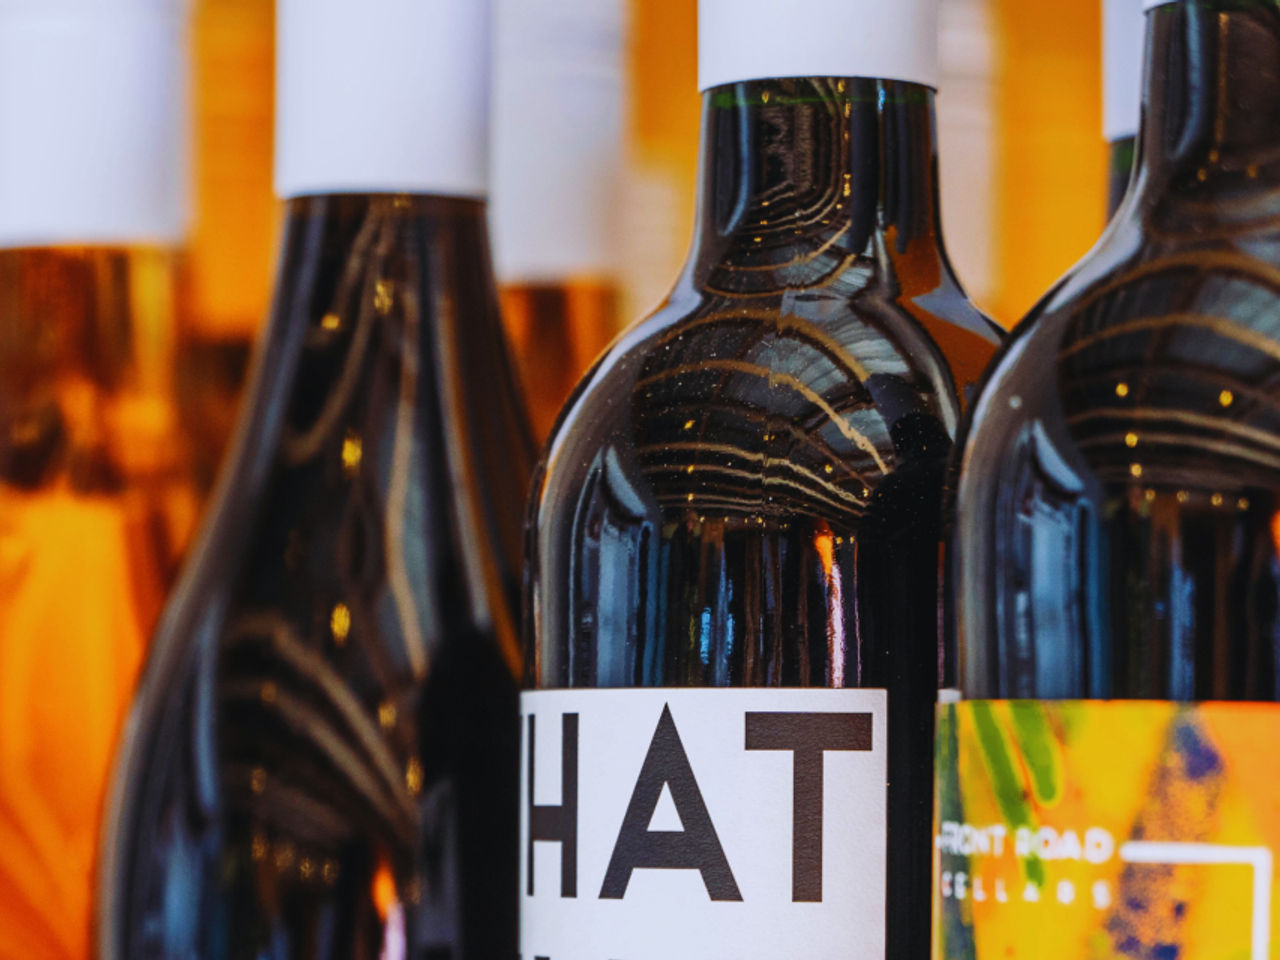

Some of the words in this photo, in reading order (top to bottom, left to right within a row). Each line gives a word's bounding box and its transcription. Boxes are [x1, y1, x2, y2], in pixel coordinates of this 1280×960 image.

[520, 702, 873, 903] HAT
[940, 820, 1006, 858] FRONT
[1016, 825, 1115, 864] ROAD
